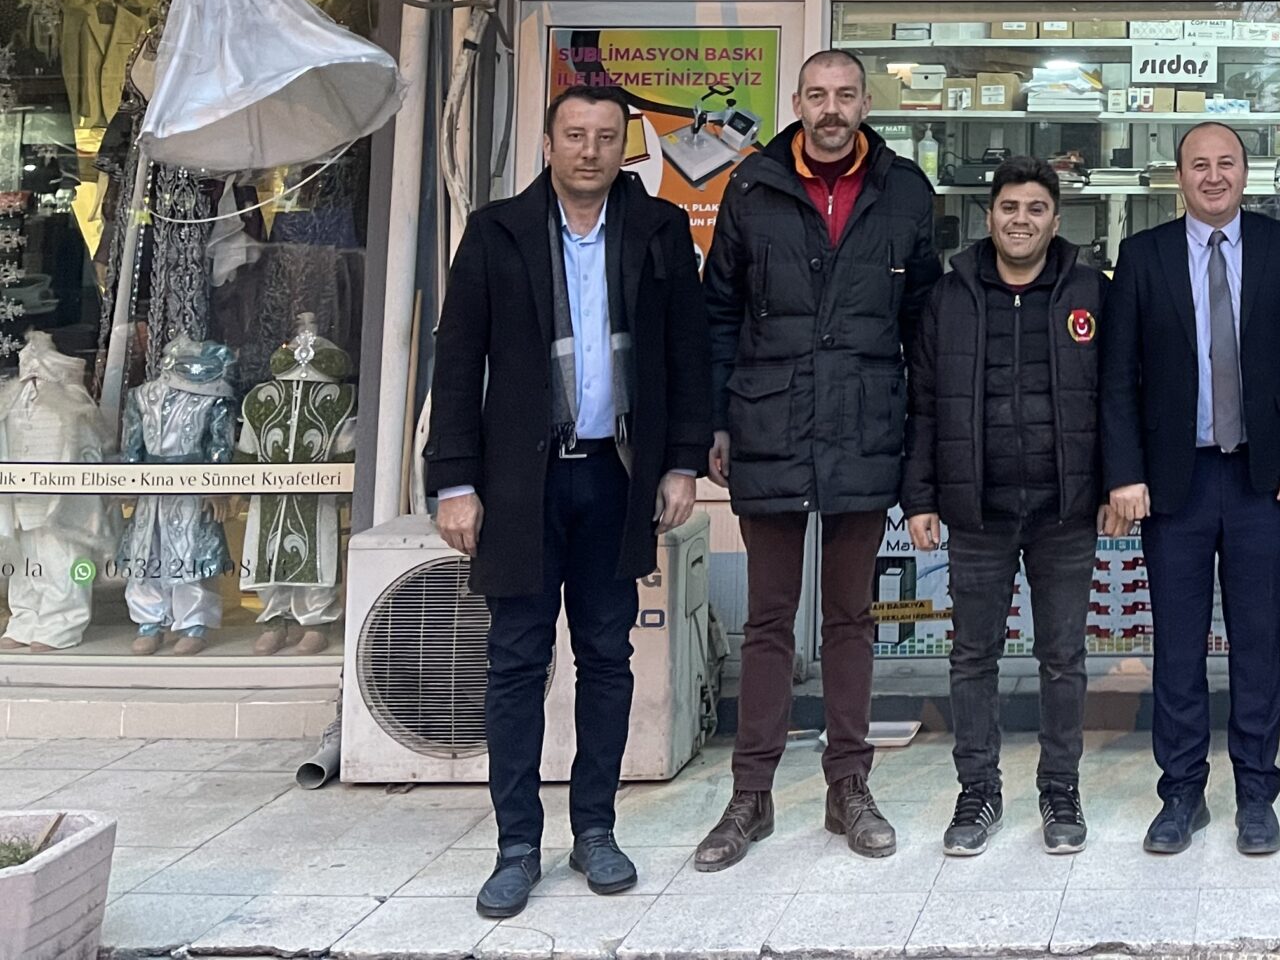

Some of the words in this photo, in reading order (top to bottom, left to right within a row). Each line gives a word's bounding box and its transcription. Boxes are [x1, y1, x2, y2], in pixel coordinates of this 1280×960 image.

[558, 43, 699, 62] SUBLİMASYON
[704, 47, 763, 62] BASKI
[591, 68, 762, 87] HİZMETİNİZDEYİZ
[30, 472, 75, 486] Takım
[81, 472, 126, 486] Elbise
[140, 472, 174, 486] Kına
[179, 475, 197, 486] ve
[201, 472, 256, 486] Sünnet
[262, 472, 342, 489] Kıyafetleri
